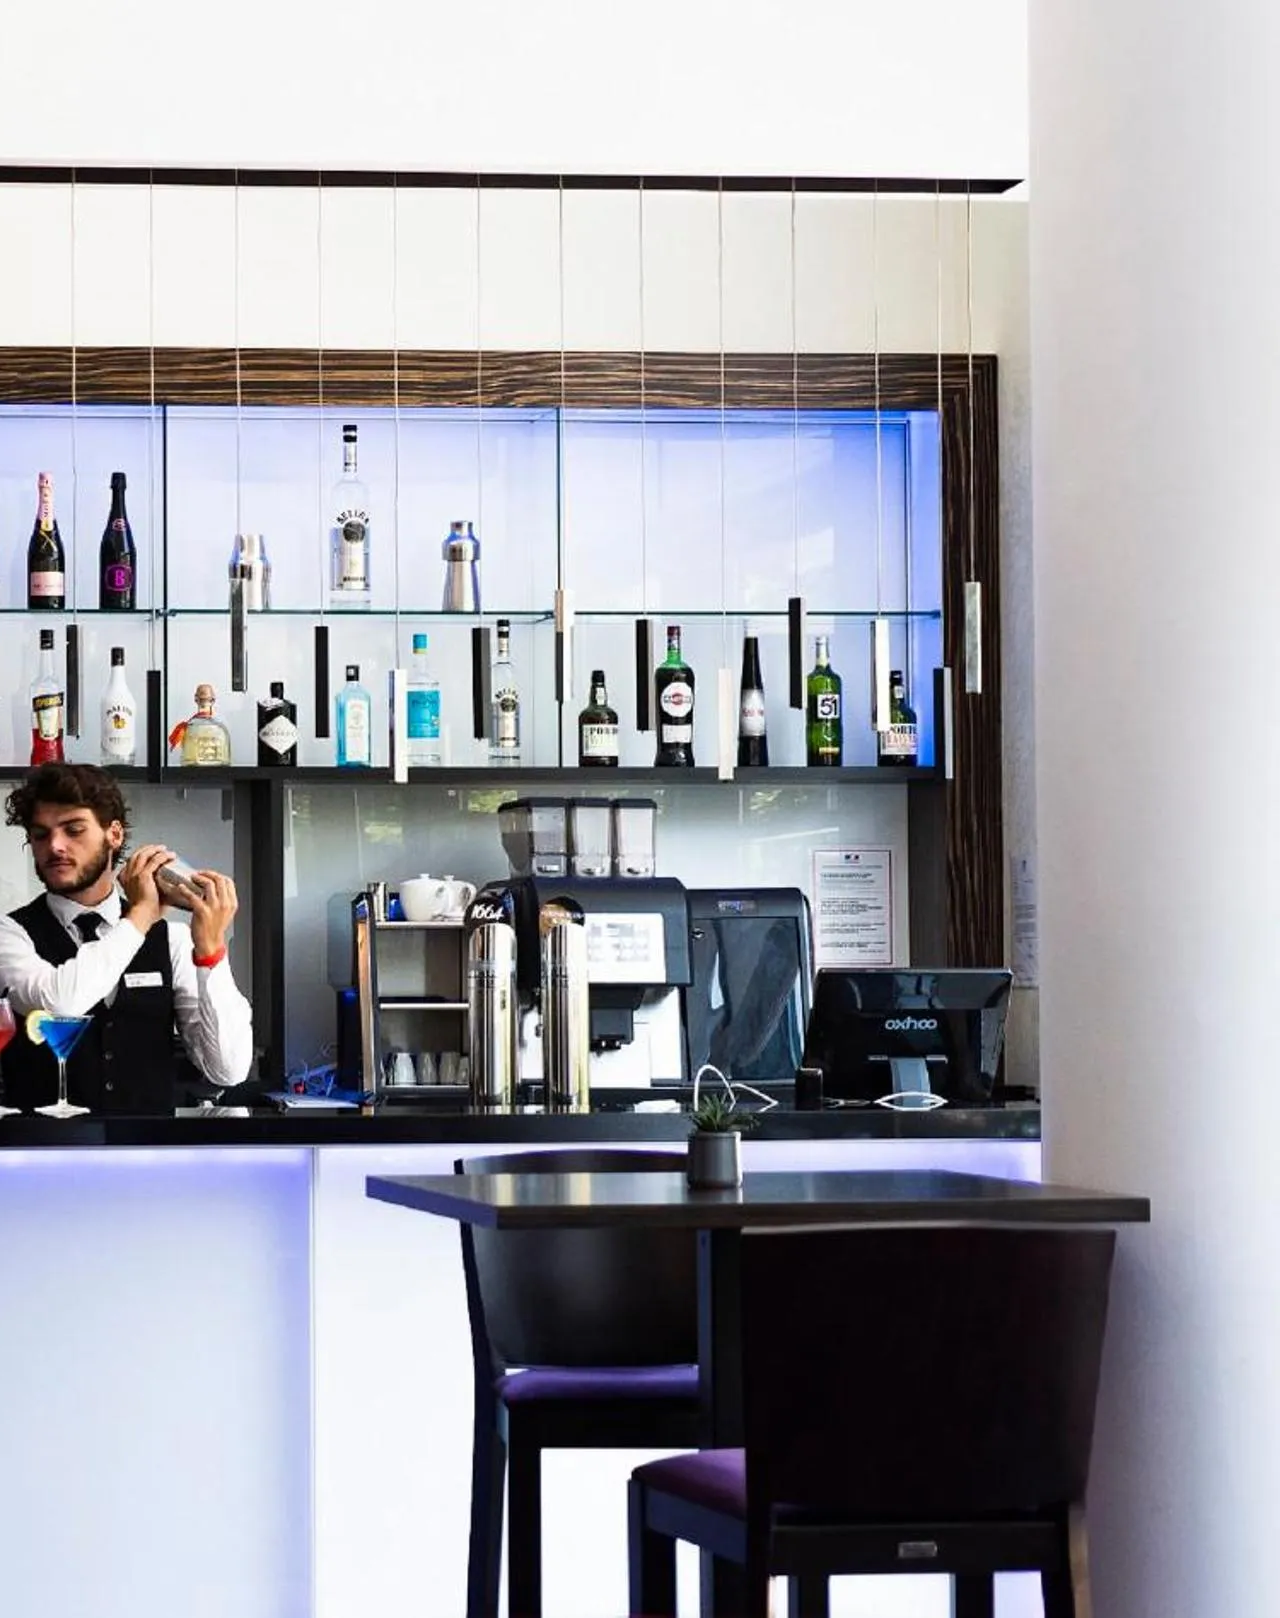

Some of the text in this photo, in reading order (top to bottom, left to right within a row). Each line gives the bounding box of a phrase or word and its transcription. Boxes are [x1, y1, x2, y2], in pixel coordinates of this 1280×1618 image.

[821, 696, 837, 716] 51
[471, 903, 505, 920] 1664
[885, 1016, 938, 1030] oxhoo
